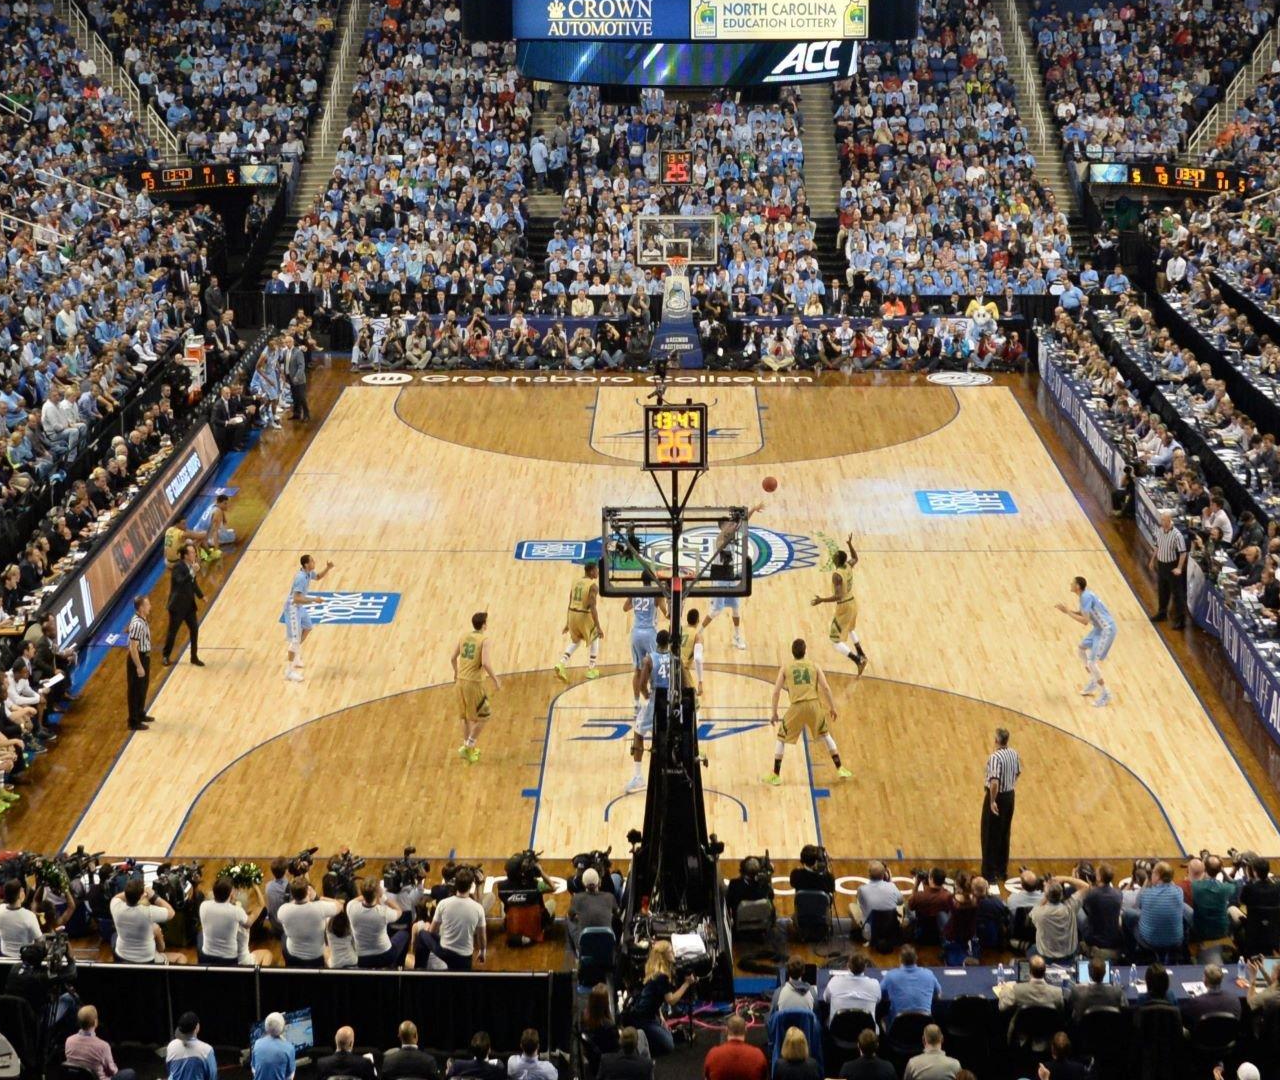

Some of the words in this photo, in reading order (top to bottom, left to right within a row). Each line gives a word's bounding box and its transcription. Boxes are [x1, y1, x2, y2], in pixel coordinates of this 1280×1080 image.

[722, 2, 767, 16] NORTH
[771, 2, 837, 16] CAROLINA
[547, 21, 653, 37] AUTOMOTIVE
[722, 18, 787, 29] EDUCATION
[790, 18, 838, 29] LOTTERY
[770, 41, 842, 74] ACC
[227, 173, 235, 184] 5
[1178, 167, 1205, 180] 13:47
[420, 374, 634, 384] Greensboro
[645, 374, 813, 384] Coliseum
[655, 411, 699, 429] 13:47
[320, 593, 362, 624] YORK
[352, 595, 388, 619] LIFE
[634, 597, 650, 612] 22
[461, 641, 476, 660] 32
[792, 669, 812, 686] 24
[1255, 664, 1272, 718] LIFE
